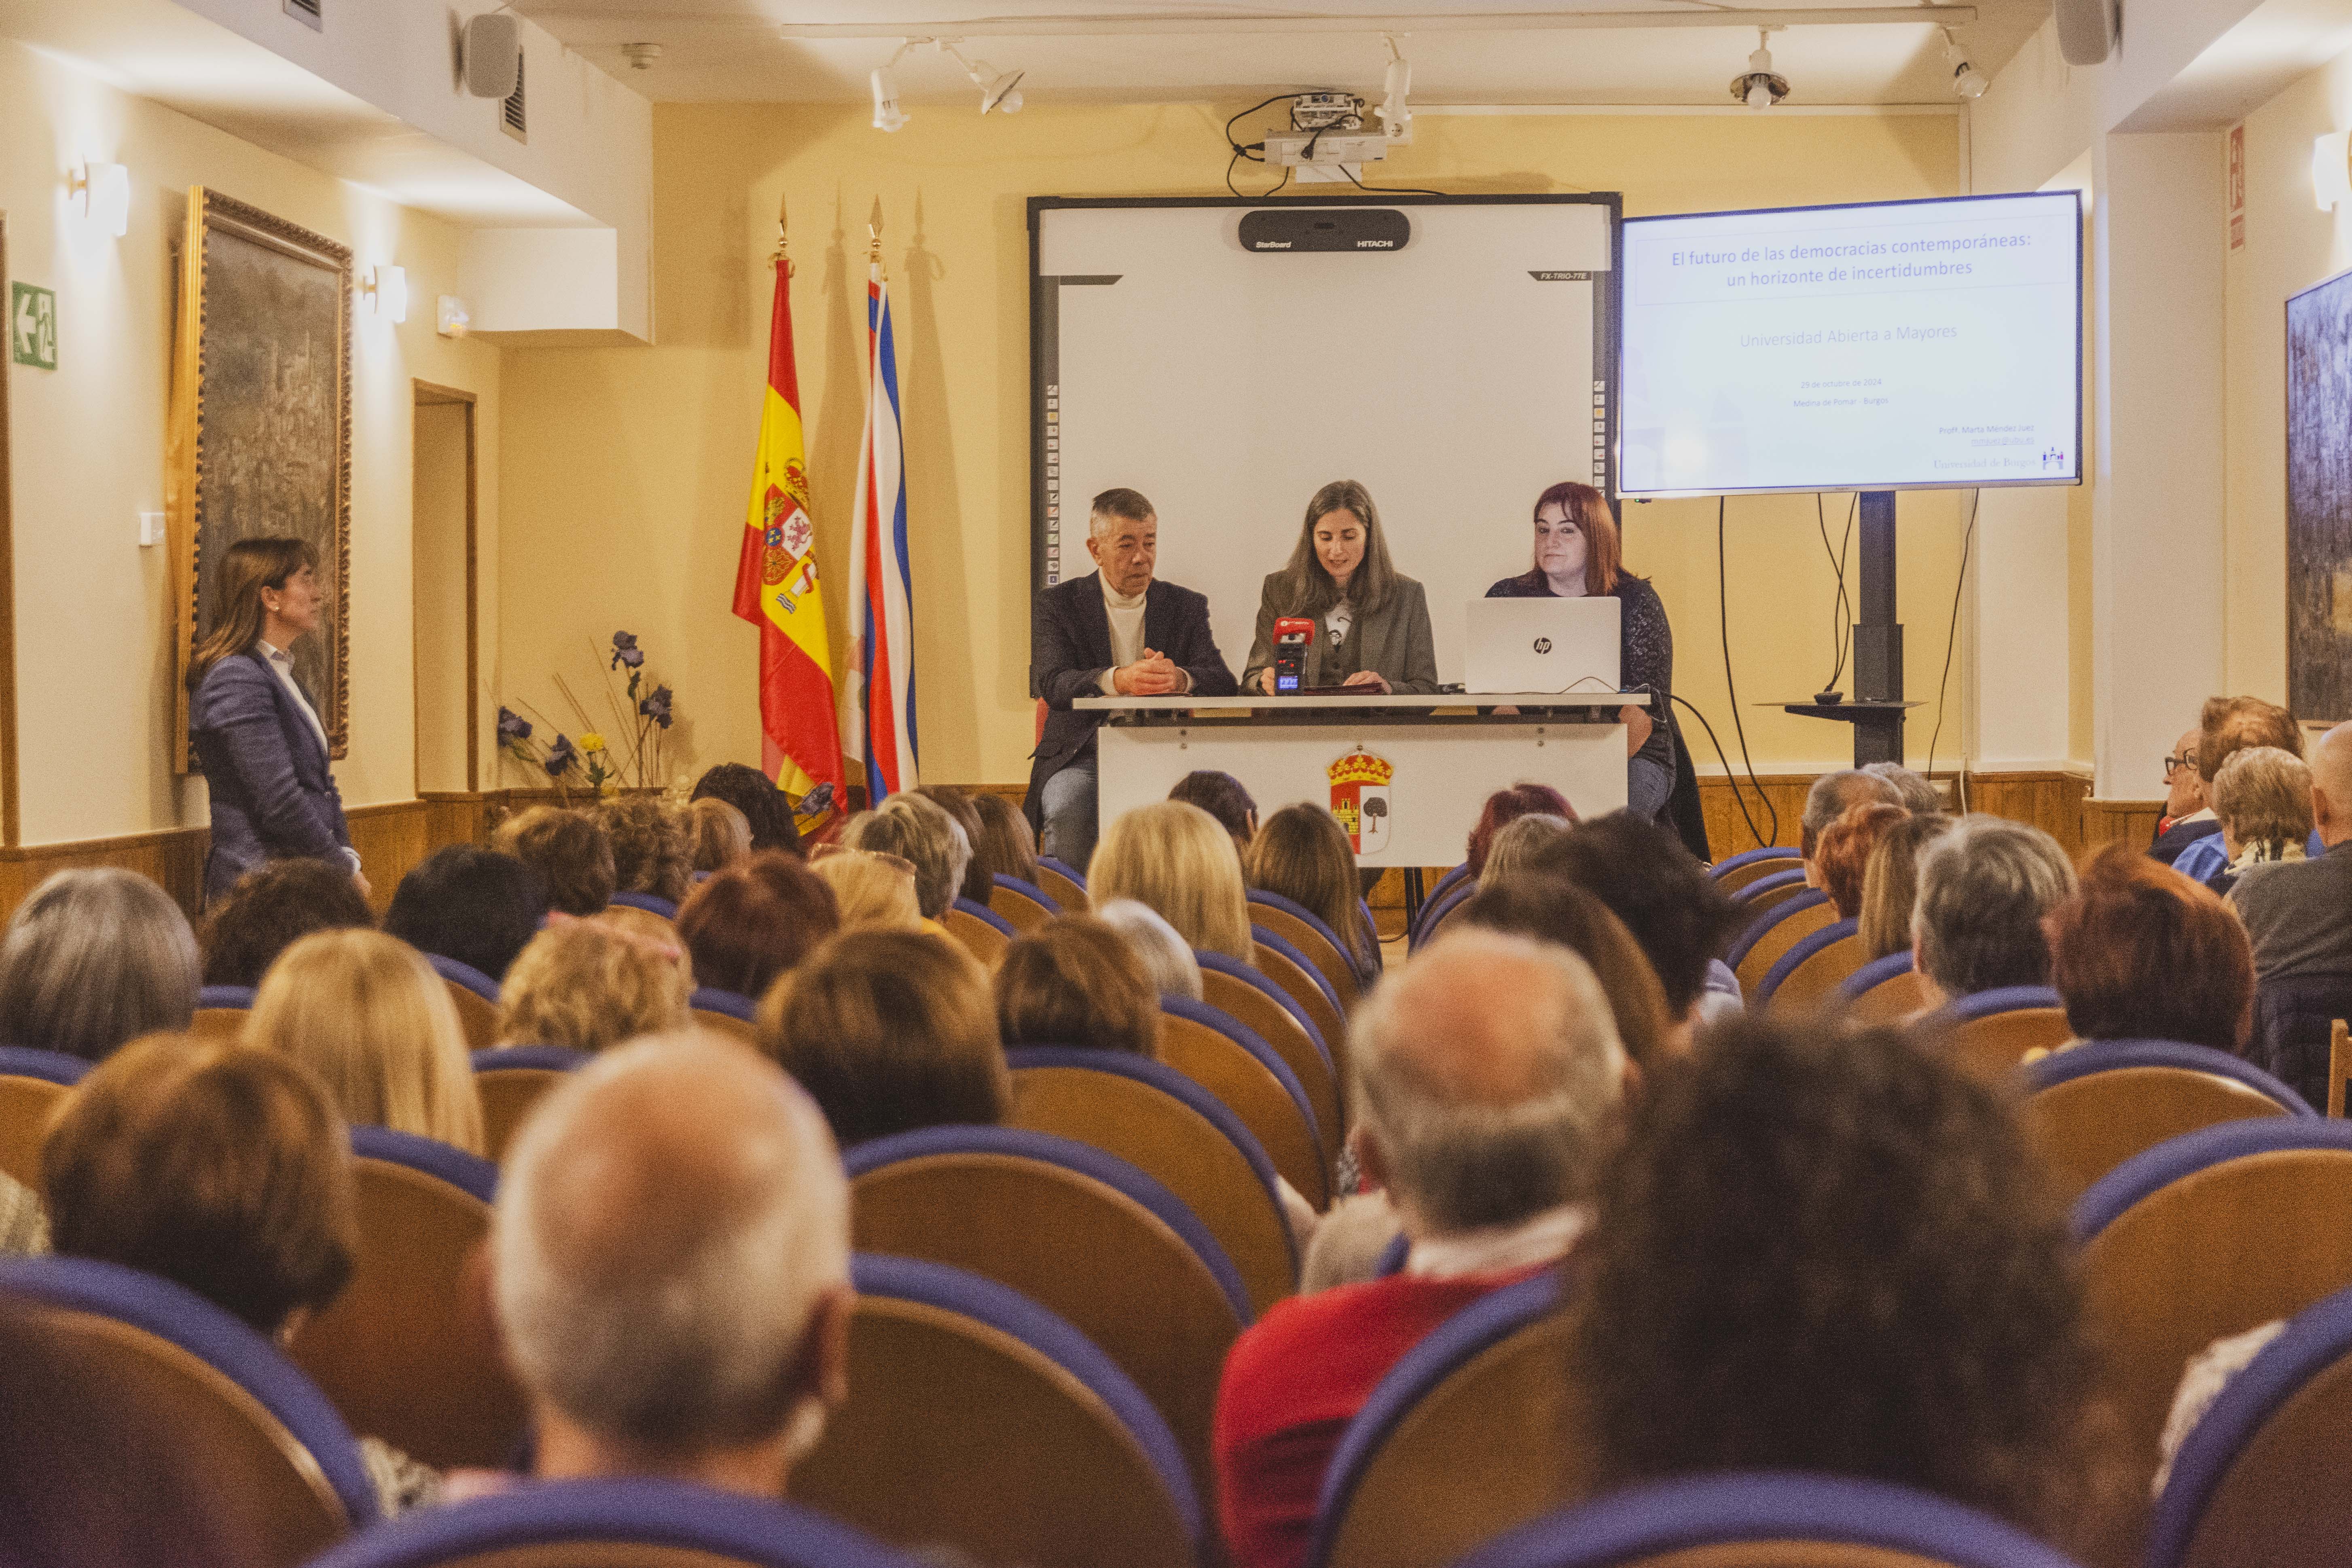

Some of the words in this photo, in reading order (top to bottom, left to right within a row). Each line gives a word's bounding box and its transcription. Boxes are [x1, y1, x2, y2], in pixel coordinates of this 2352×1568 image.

[1672, 252, 1685, 266] El
[1689, 251, 1736, 265] futuro
[1741, 248, 1760, 262] de
[1765, 247, 1785, 260] las
[1790, 241, 1887, 259] democracias
[1892, 233, 2031, 253] contemporáneas:
[1727, 276, 1746, 287] un
[1751, 271, 1824, 286] horizonte
[1829, 267, 1847, 281] de
[1852, 262, 1973, 280] incertidumbres
[1741, 330, 1822, 347] Universidad
[1828, 329, 1878, 343] Abierta
[1884, 331, 1892, 341] a
[1897, 326, 1958, 342] Mayores
[1934, 458, 1987, 468] Universidad
[1990, 457, 2001, 467] de
[2003, 458, 2035, 469] Burgos
[1535, 637, 1551, 654] hp
